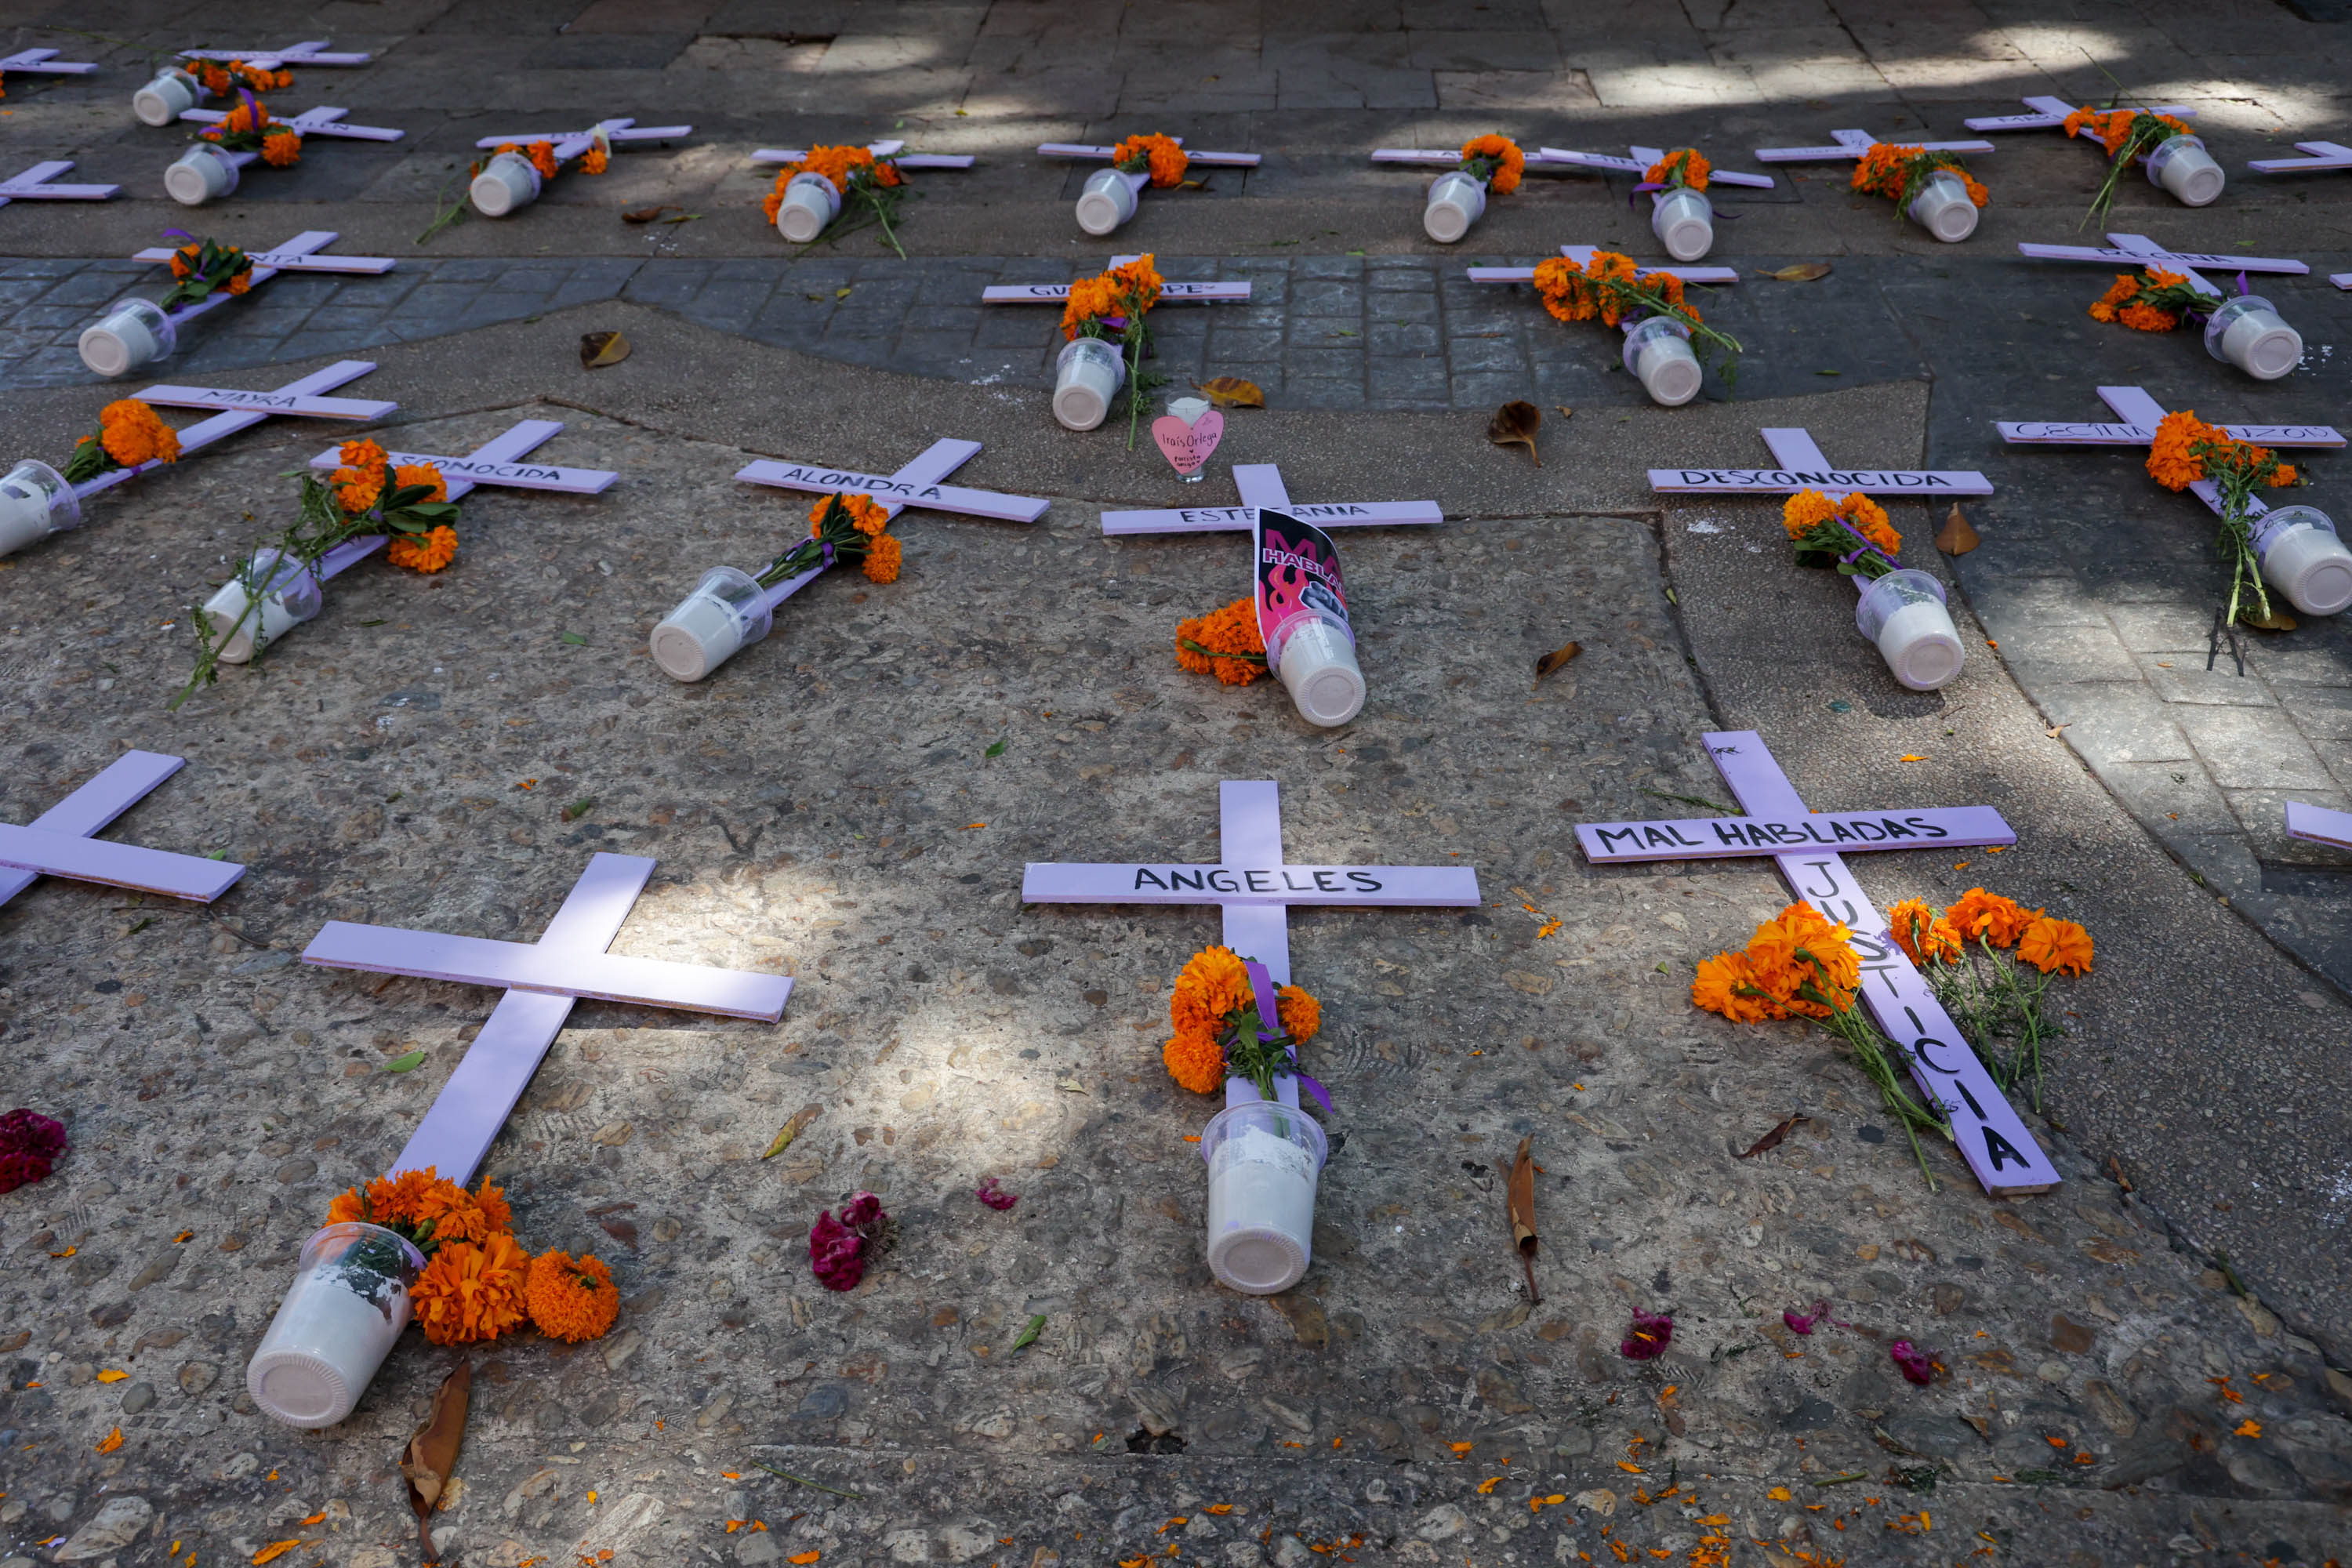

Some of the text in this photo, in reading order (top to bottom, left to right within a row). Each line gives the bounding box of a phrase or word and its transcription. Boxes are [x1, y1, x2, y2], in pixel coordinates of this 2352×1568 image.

[2096, 248, 2234, 263] REGINA
[197, 390, 296, 407] MAYRA
[784, 468, 942, 499] ALONDRA
[1680, 470, 1953, 486] DESCONOCIDA
[1180, 504, 1370, 523] ESTEANIA
[1595, 817, 1948, 854] MAL HABLADAS
[1134, 867, 1383, 893] ANGELES
[1802, 861, 2031, 1172] JUSTICIA
